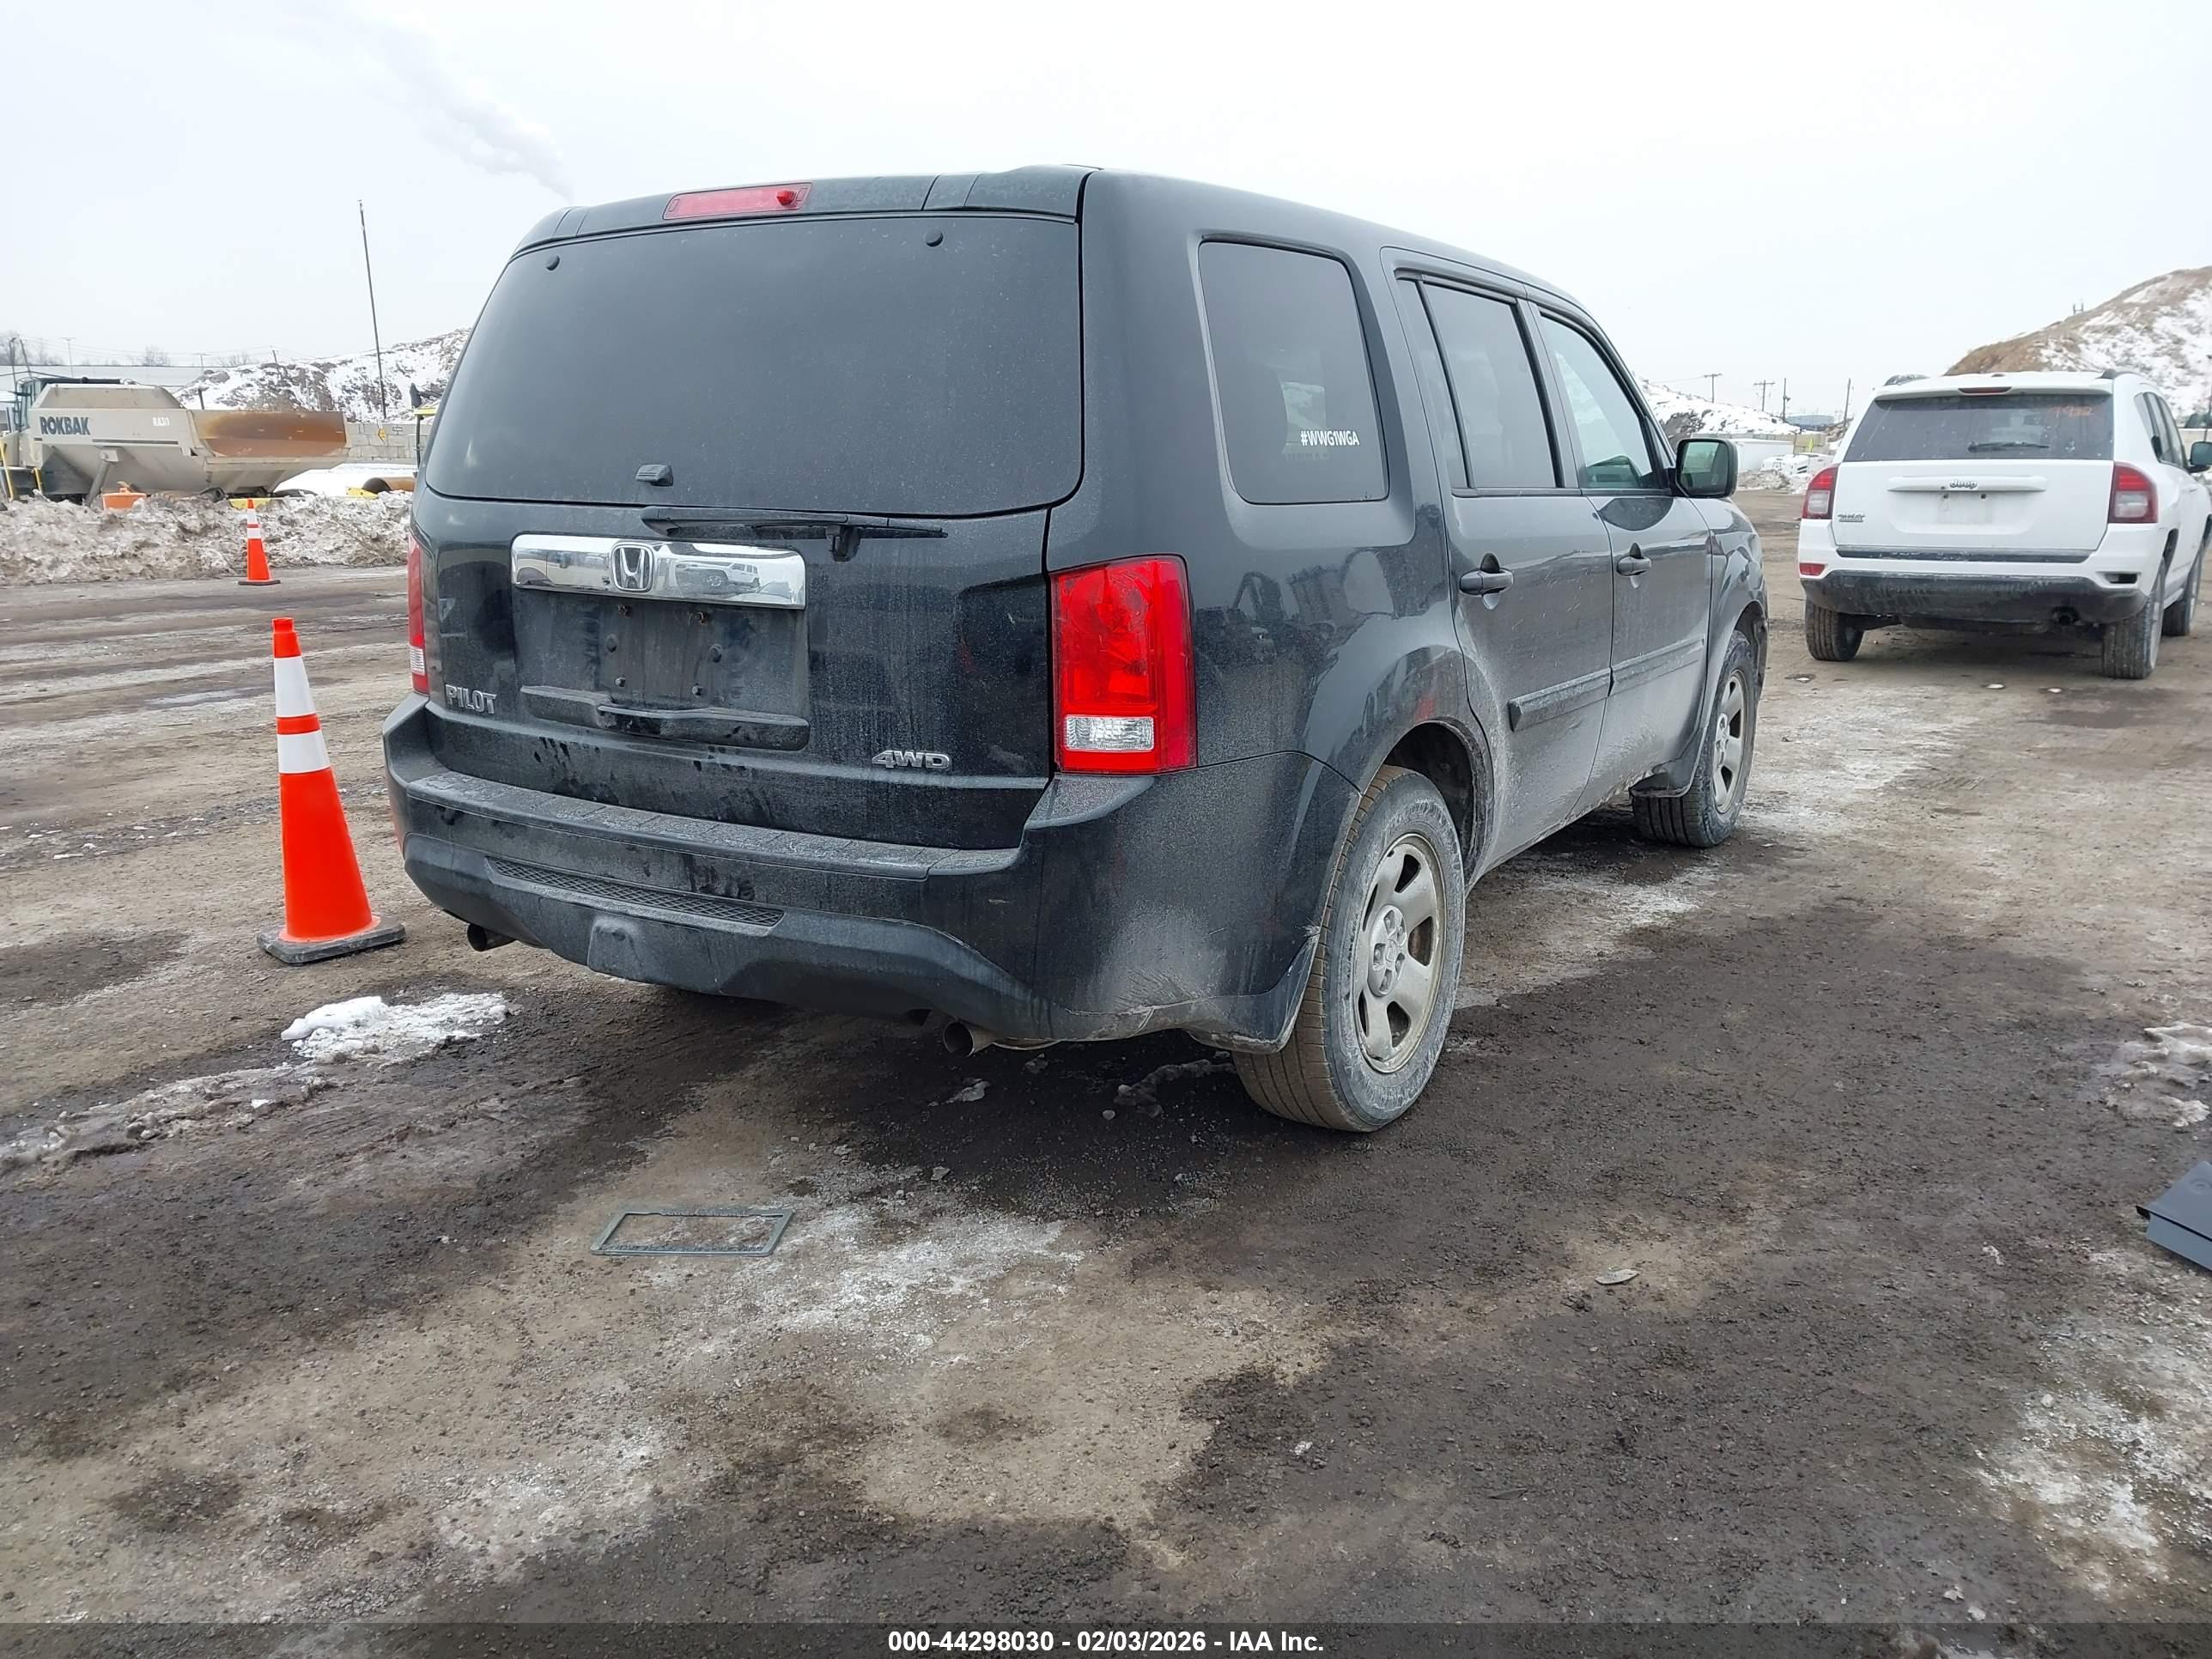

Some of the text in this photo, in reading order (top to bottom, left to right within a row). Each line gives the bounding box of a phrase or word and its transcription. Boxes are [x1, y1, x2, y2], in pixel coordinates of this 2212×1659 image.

[40, 416, 91, 435] ROKBAK
[1300, 430, 1360, 447] #WWG1WGA
[1949, 479, 1978, 489] Jeep
[445, 684, 498, 714] PILOT
[872, 749, 951, 770] 4WD
